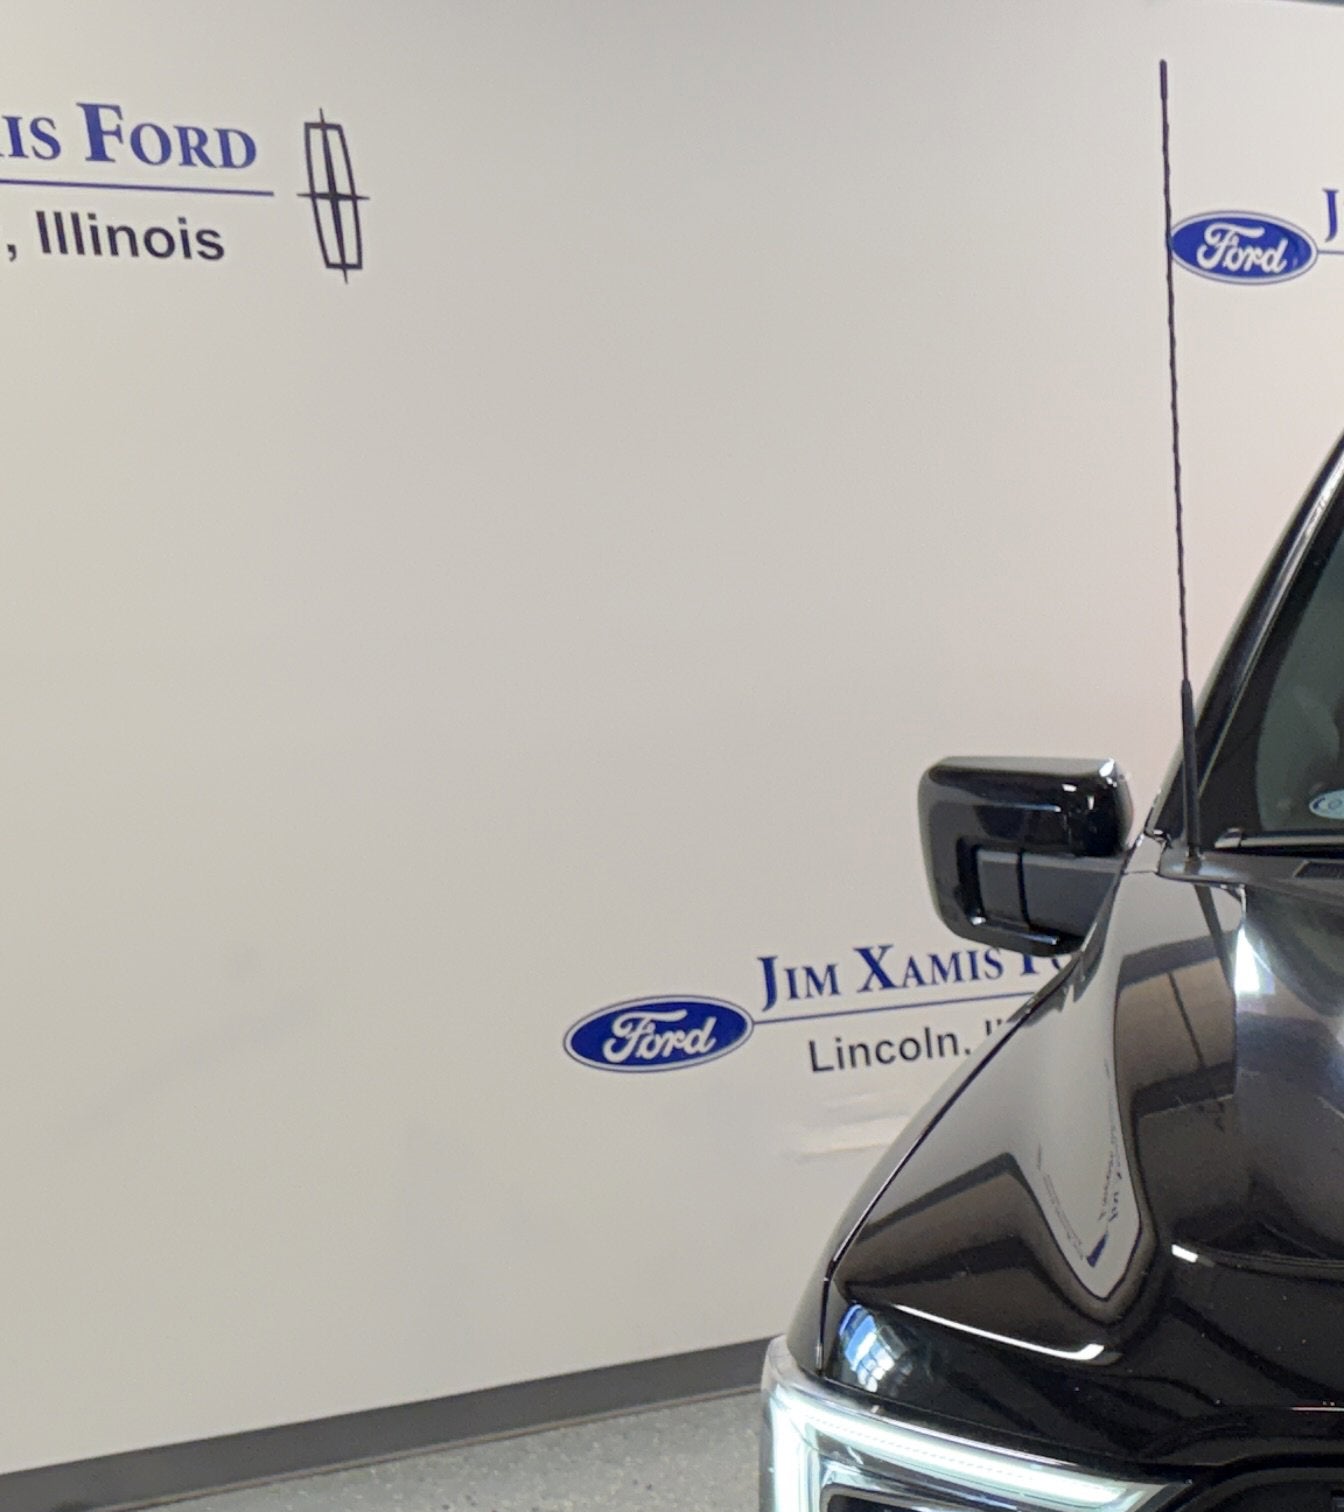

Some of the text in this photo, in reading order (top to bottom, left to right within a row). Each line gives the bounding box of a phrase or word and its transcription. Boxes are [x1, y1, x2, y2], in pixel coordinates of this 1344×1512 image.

[76, 102, 257, 169] FORD
[35, 210, 225, 260] Illinois
[1196, 222, 1288, 274] Ford
[756, 955, 840, 1012] JIM
[852, 944, 1003, 994] XAMIS
[603, 1009, 718, 1063] Ford
